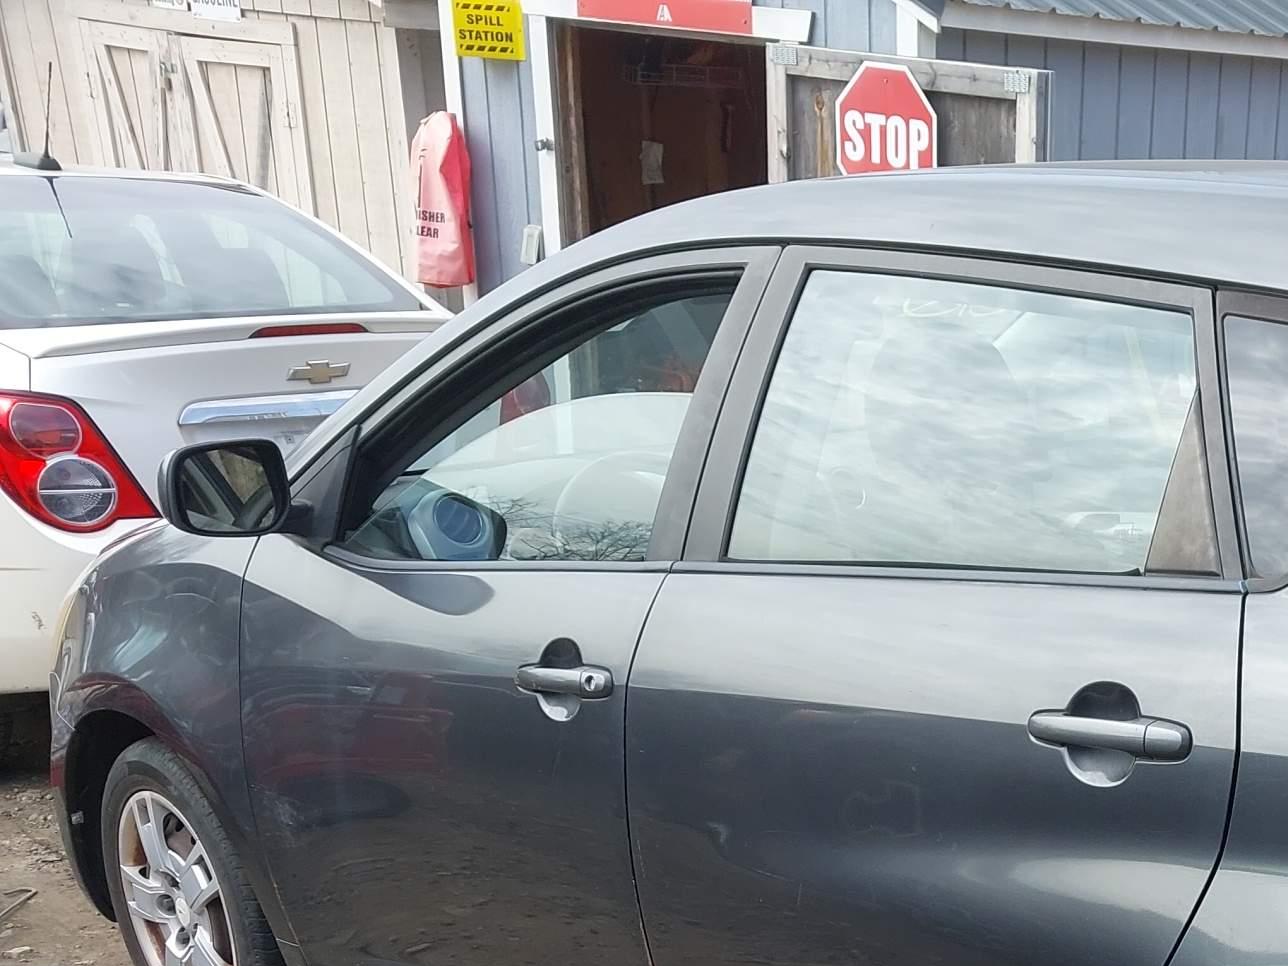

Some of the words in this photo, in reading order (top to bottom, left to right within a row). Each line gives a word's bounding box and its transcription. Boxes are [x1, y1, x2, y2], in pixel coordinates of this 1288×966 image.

[466, 14, 503, 27] SPILL
[459, 29, 513, 43] STATION
[844, 109, 929, 169] STOP
